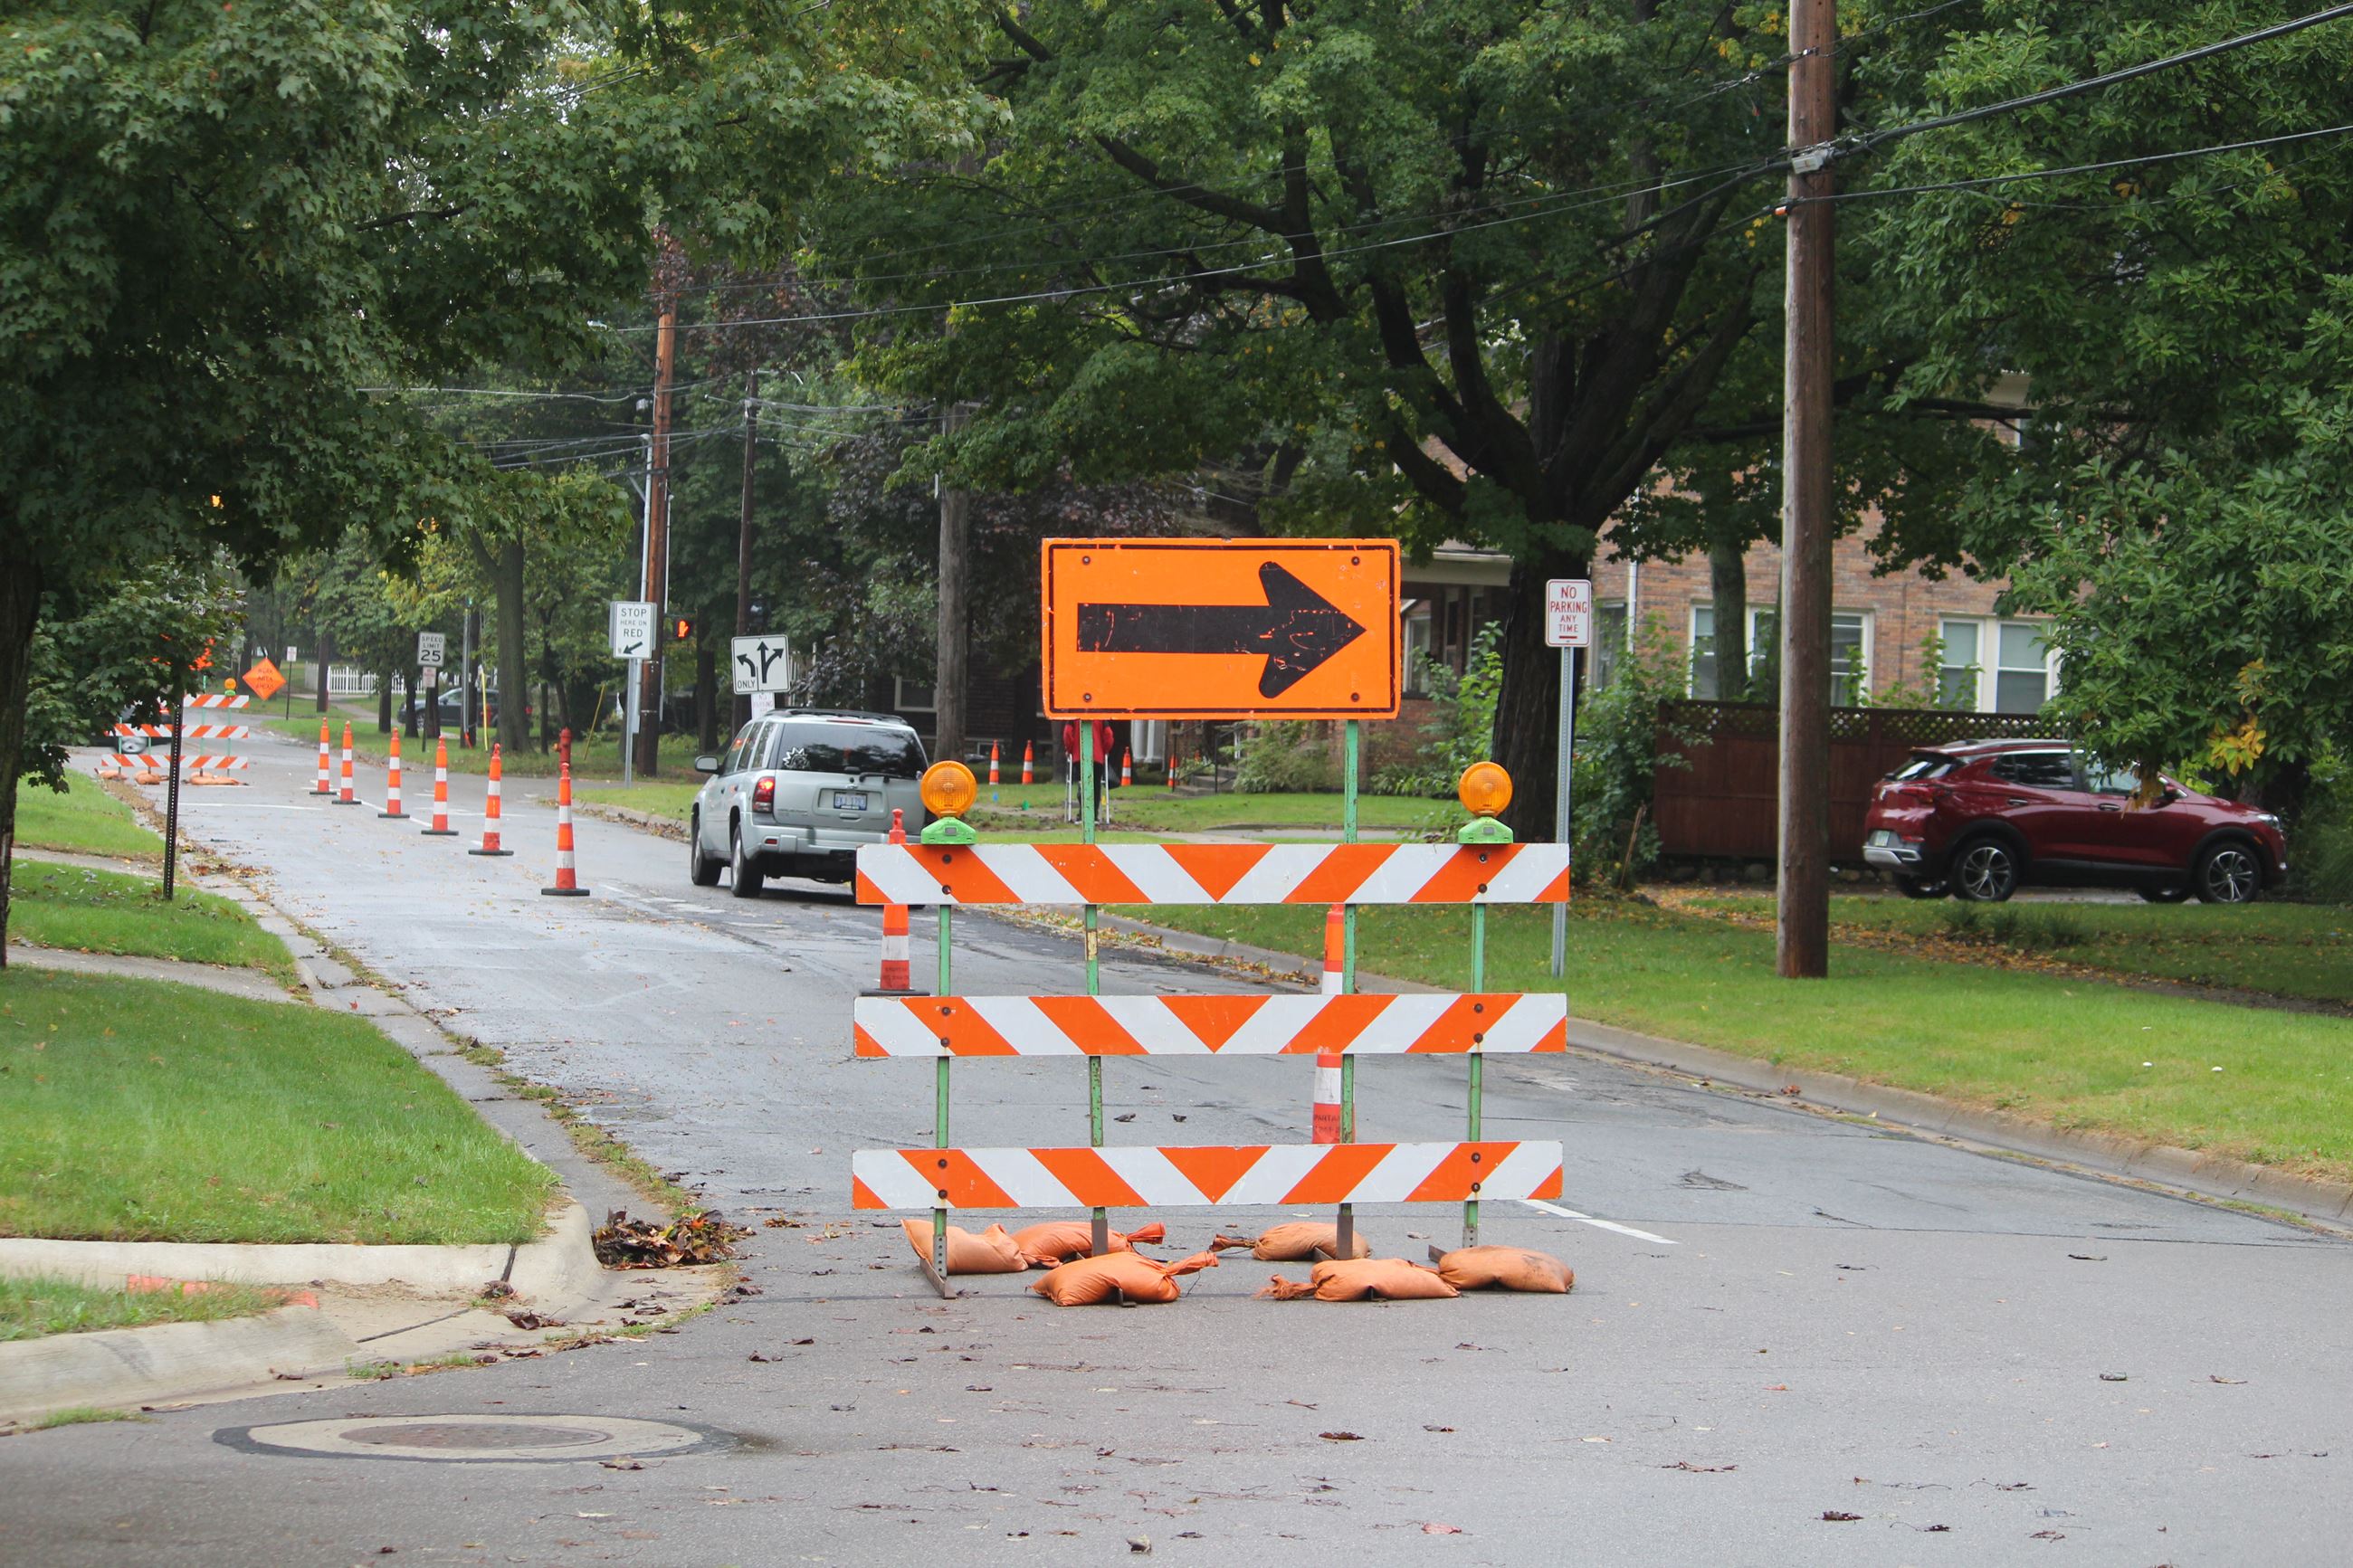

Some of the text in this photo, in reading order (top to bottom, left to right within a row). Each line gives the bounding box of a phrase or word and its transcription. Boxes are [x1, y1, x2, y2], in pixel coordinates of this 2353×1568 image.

[1561, 586, 1577, 599] NO
[1550, 601, 1587, 613] PARKING
[621, 608, 647, 617] STOP
[624, 628, 643, 638] RED
[1558, 624, 1578, 632] TIME
[421, 650, 441, 661] 25
[738, 679, 756, 689] ONLY
